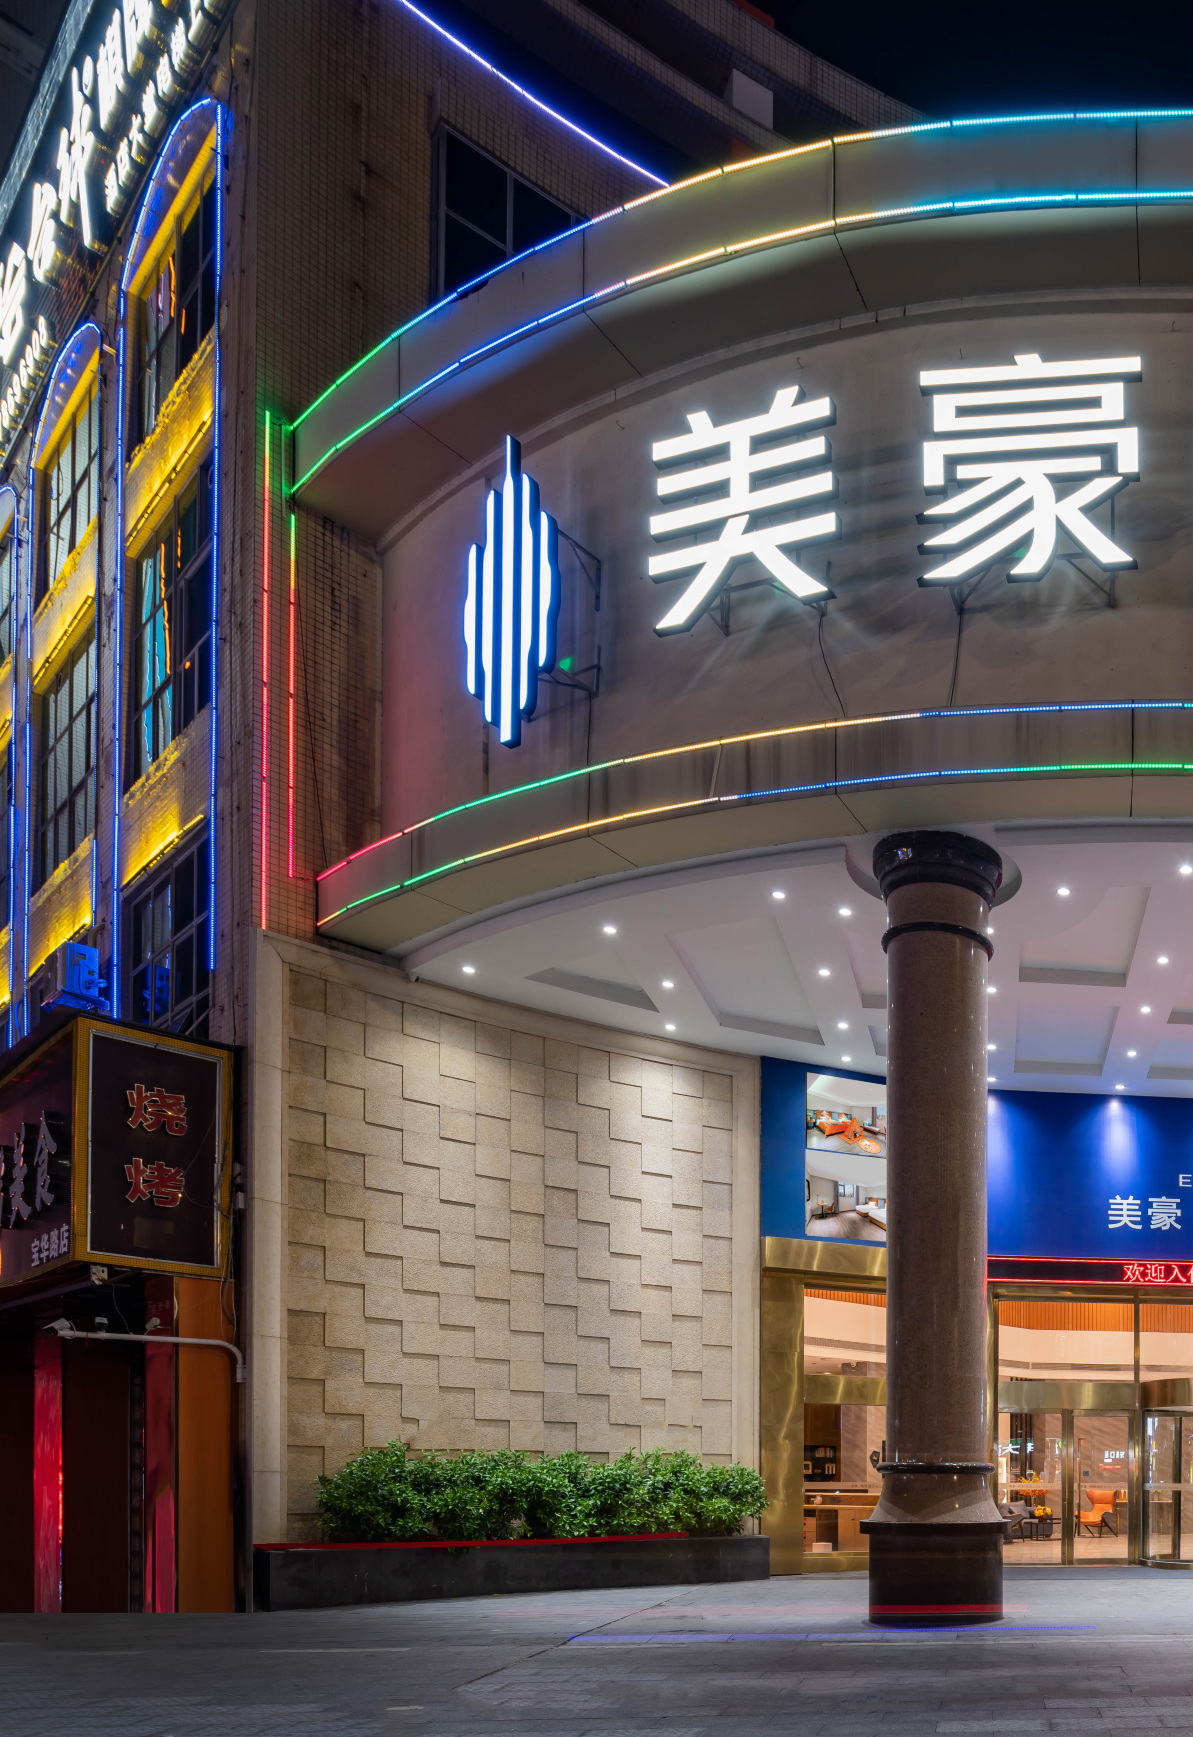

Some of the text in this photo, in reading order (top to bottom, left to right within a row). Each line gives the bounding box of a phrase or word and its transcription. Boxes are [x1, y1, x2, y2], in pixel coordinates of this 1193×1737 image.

[104, 0, 210, 213] 酒店大堂电梯上
[0, 314, 47, 442] 8696908
[0, 1109, 58, 1230] 美食
[124, 1082, 188, 1208] 烧烤
[30, 1223, 69, 1268] 宝华路店
